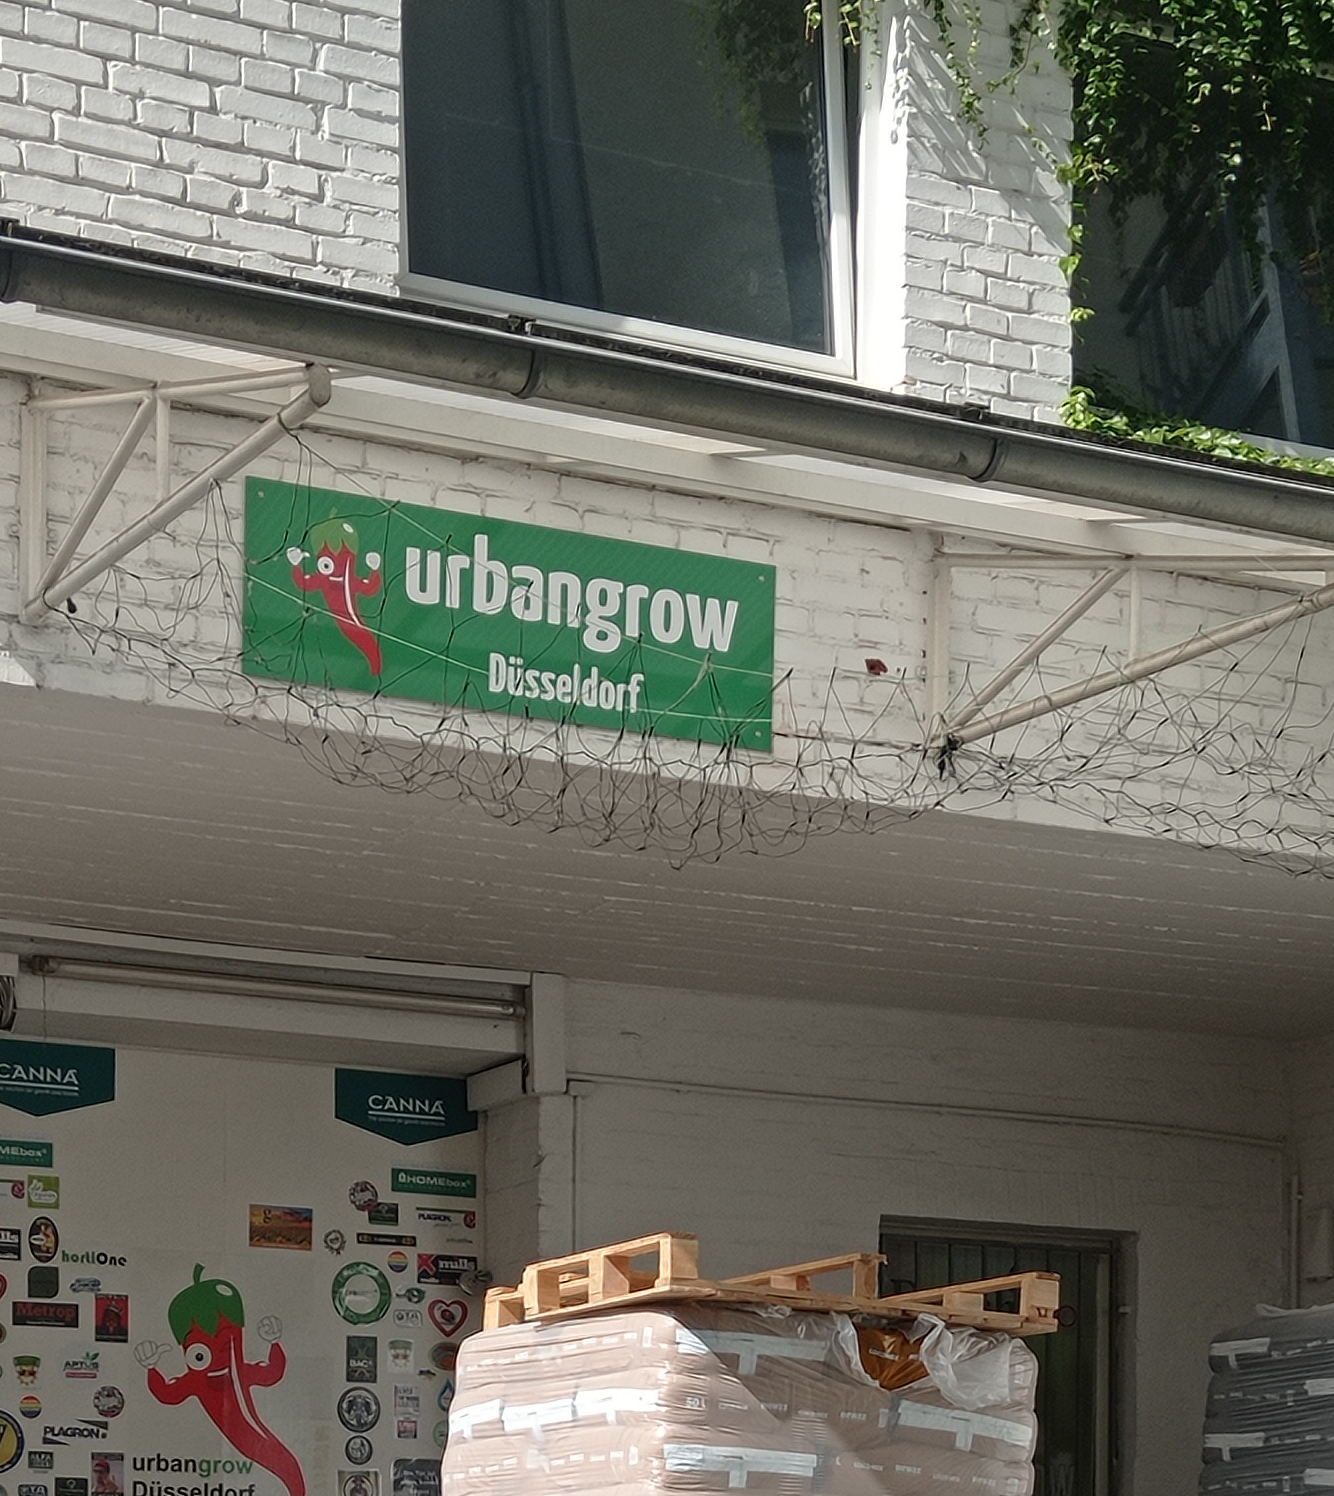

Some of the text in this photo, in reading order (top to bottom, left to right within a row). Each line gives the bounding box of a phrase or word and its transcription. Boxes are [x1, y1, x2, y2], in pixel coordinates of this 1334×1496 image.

[405, 533, 740, 653] urbangrow
[488, 652, 643, 714] Düsseldorf
[367, 1094, 446, 1115] CANNA
[62, 1250, 128, 1267] hortiOne
[17, 1304, 77, 1319] Metrop
[43, 1426, 99, 1439] PLAGRON
[133, 1453, 254, 1477] urbangrow
